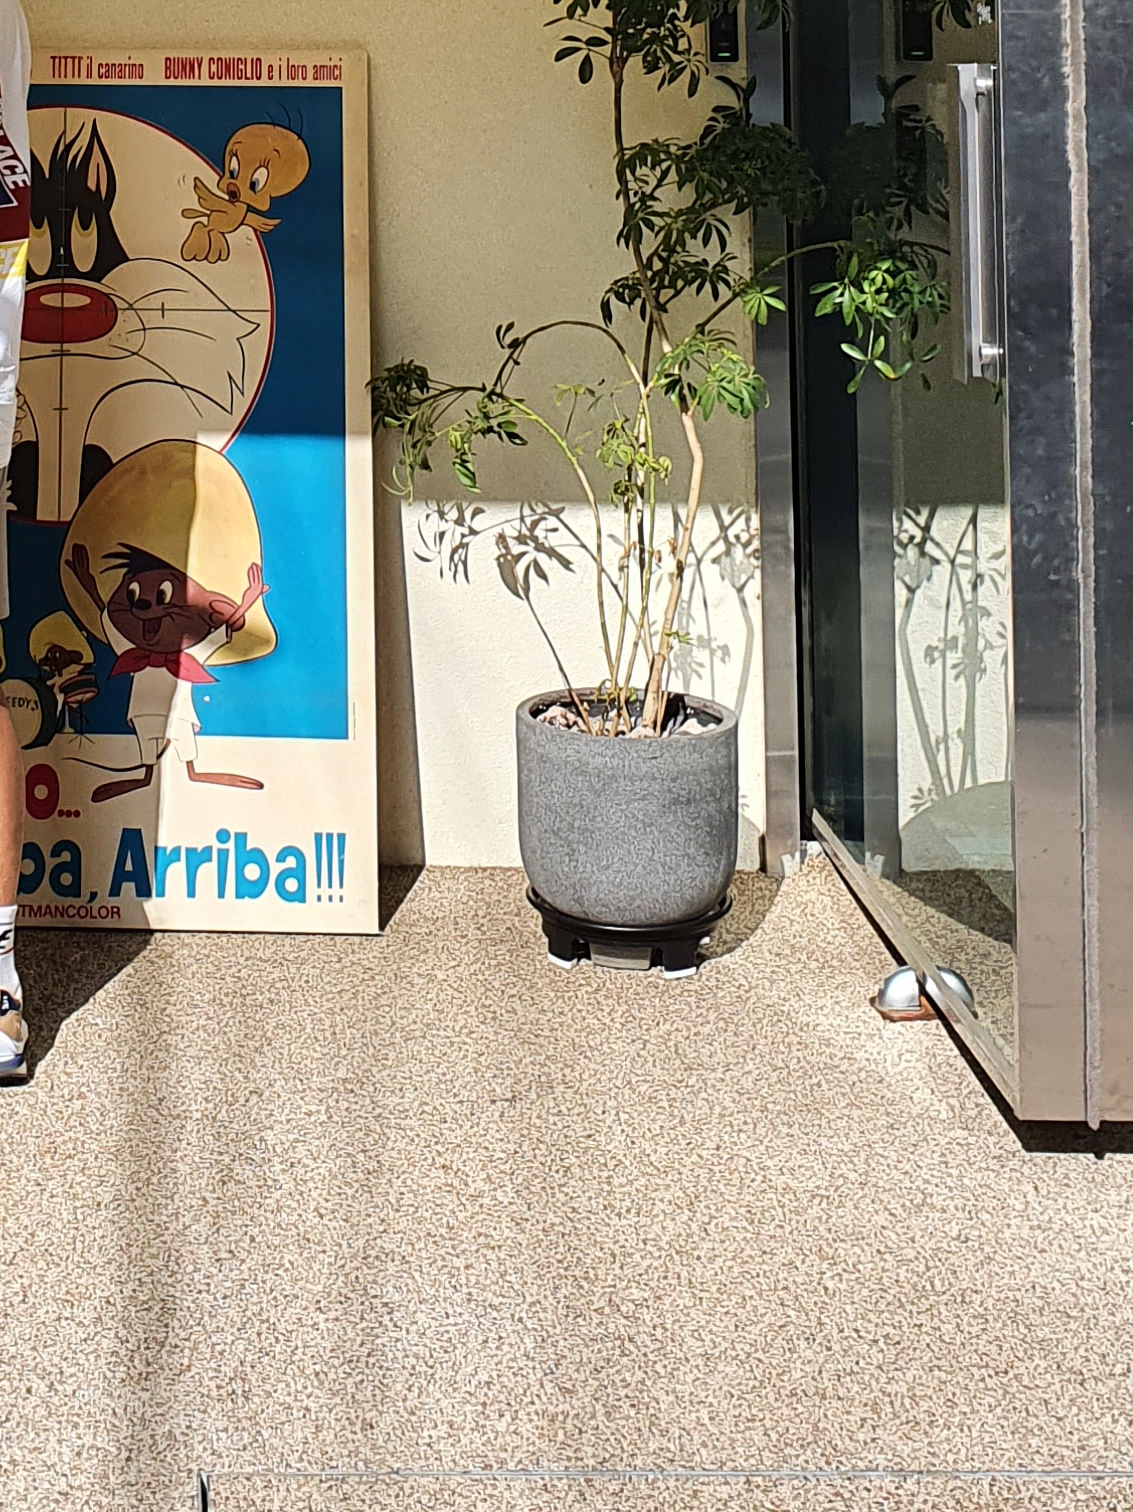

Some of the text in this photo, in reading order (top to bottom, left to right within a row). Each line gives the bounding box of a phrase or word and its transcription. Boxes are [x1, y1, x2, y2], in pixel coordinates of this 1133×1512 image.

[86, 55, 93, 80] il
[97, 55, 144, 80] canarino
[164, 56, 203, 81] BUNNY
[208, 56, 263, 81] CONIGLIO
[267, 64, 274, 81] e
[278, 57, 282, 81] i
[286, 57, 308, 81] loro
[312, 57, 343, 81] amici
[107, 827, 347, 904] Arriba!!!
[15, 904, 121, 921] TMANCOLOR
